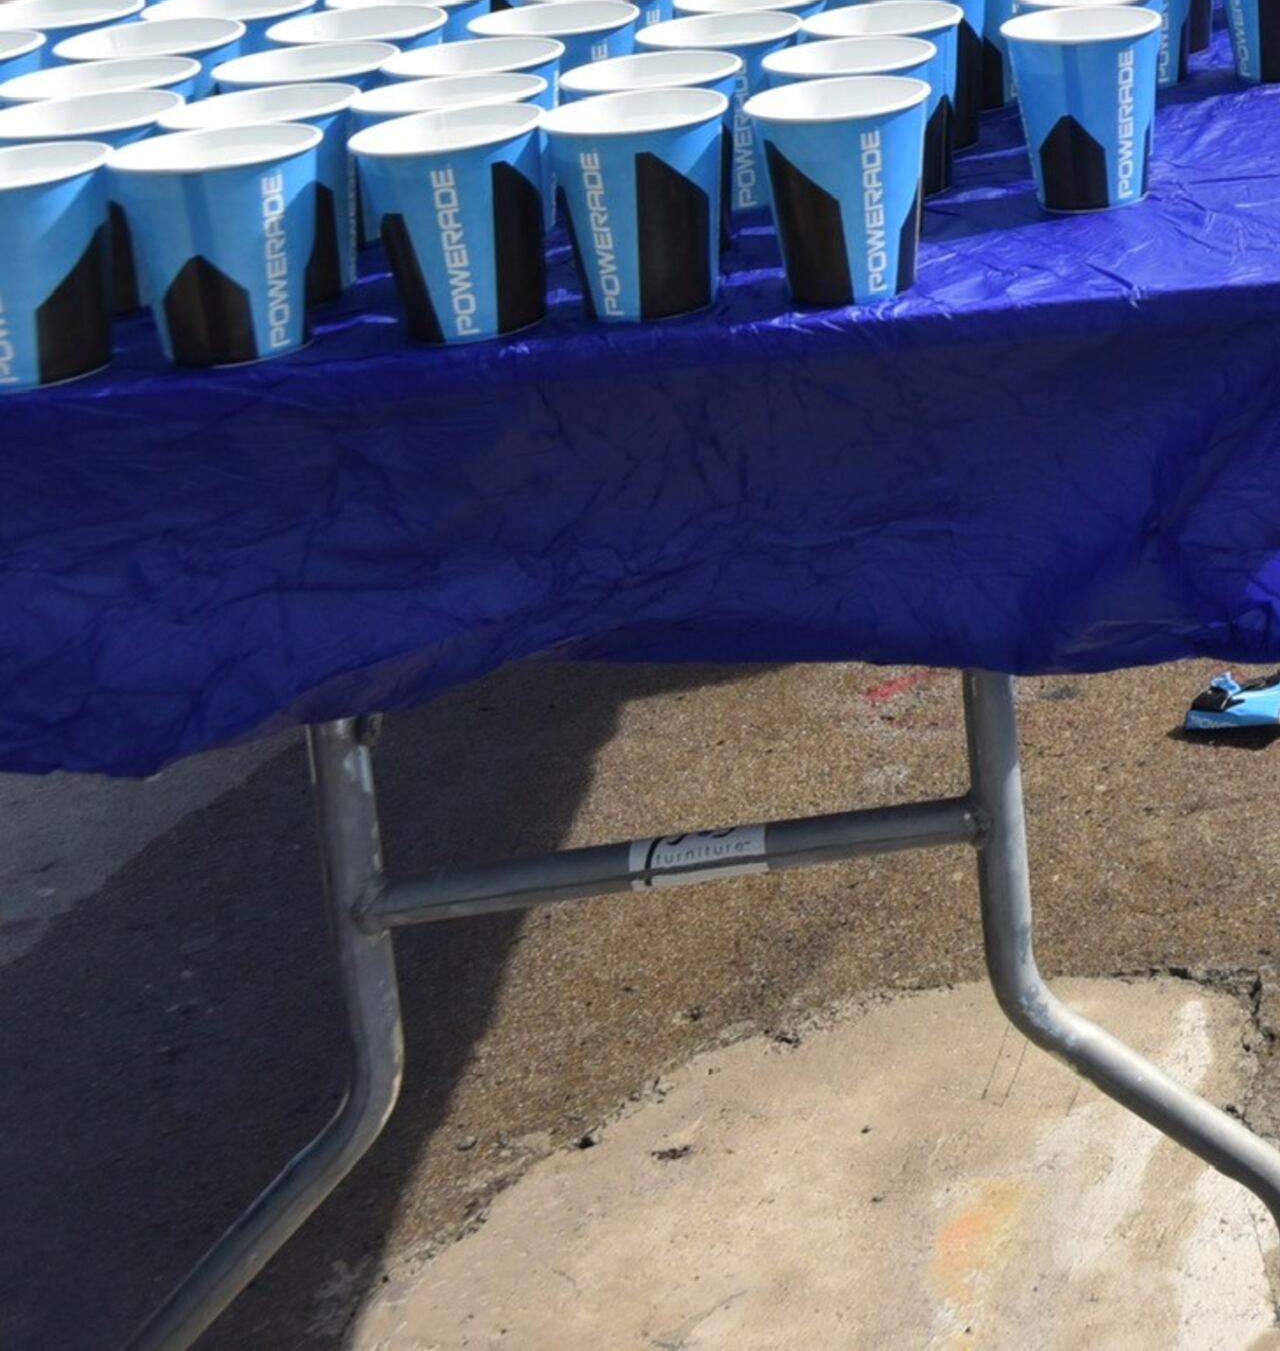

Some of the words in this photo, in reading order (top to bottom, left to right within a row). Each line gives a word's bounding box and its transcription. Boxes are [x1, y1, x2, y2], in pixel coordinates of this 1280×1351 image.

[1117, 48, 1135, 198] POWERADE
[260, 171, 292, 349] POWERADE
[429, 167, 480, 336] POWERADE
[579, 151, 624, 317] POWERADE
[861, 130, 888, 293] POWERADE
